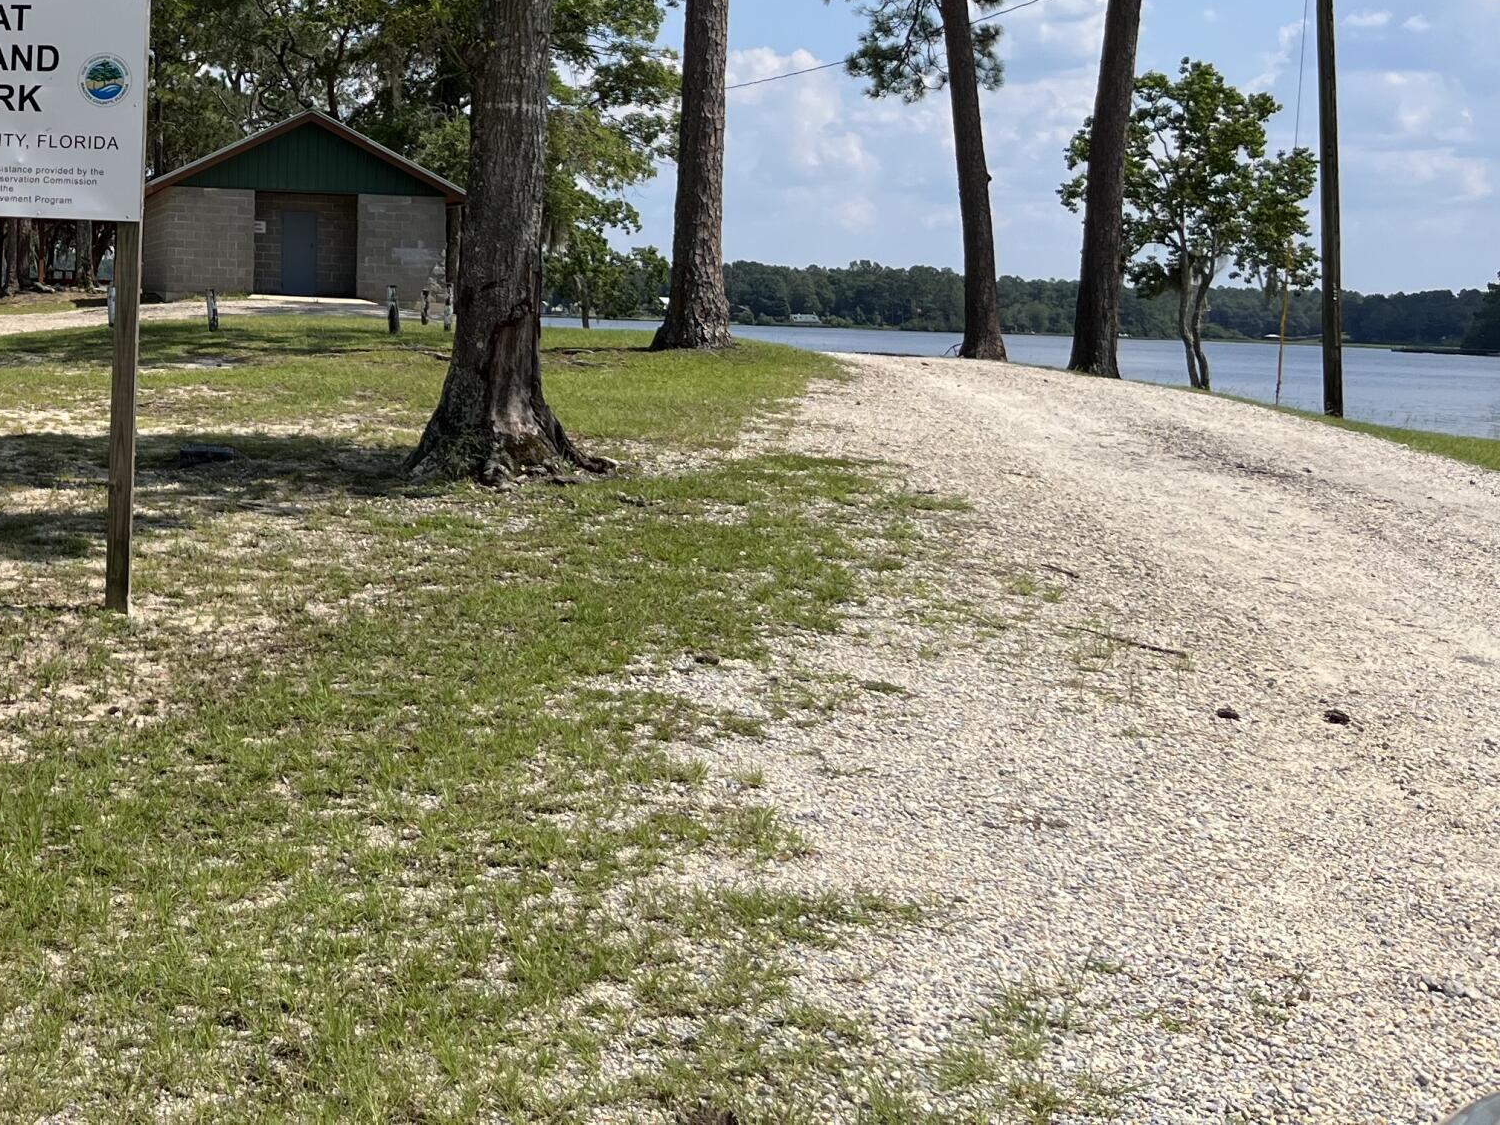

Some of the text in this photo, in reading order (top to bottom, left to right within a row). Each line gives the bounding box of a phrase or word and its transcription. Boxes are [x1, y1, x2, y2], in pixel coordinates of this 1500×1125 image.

[37, 134, 119, 150] FLORIDA
[35, 167, 74, 175] provided
[76, 167, 88, 177] by
[90, 168, 105, 176] the
[42, 176, 98, 186] Commission
[0, 184, 14, 192] the
[34, 195, 73, 206] Program
